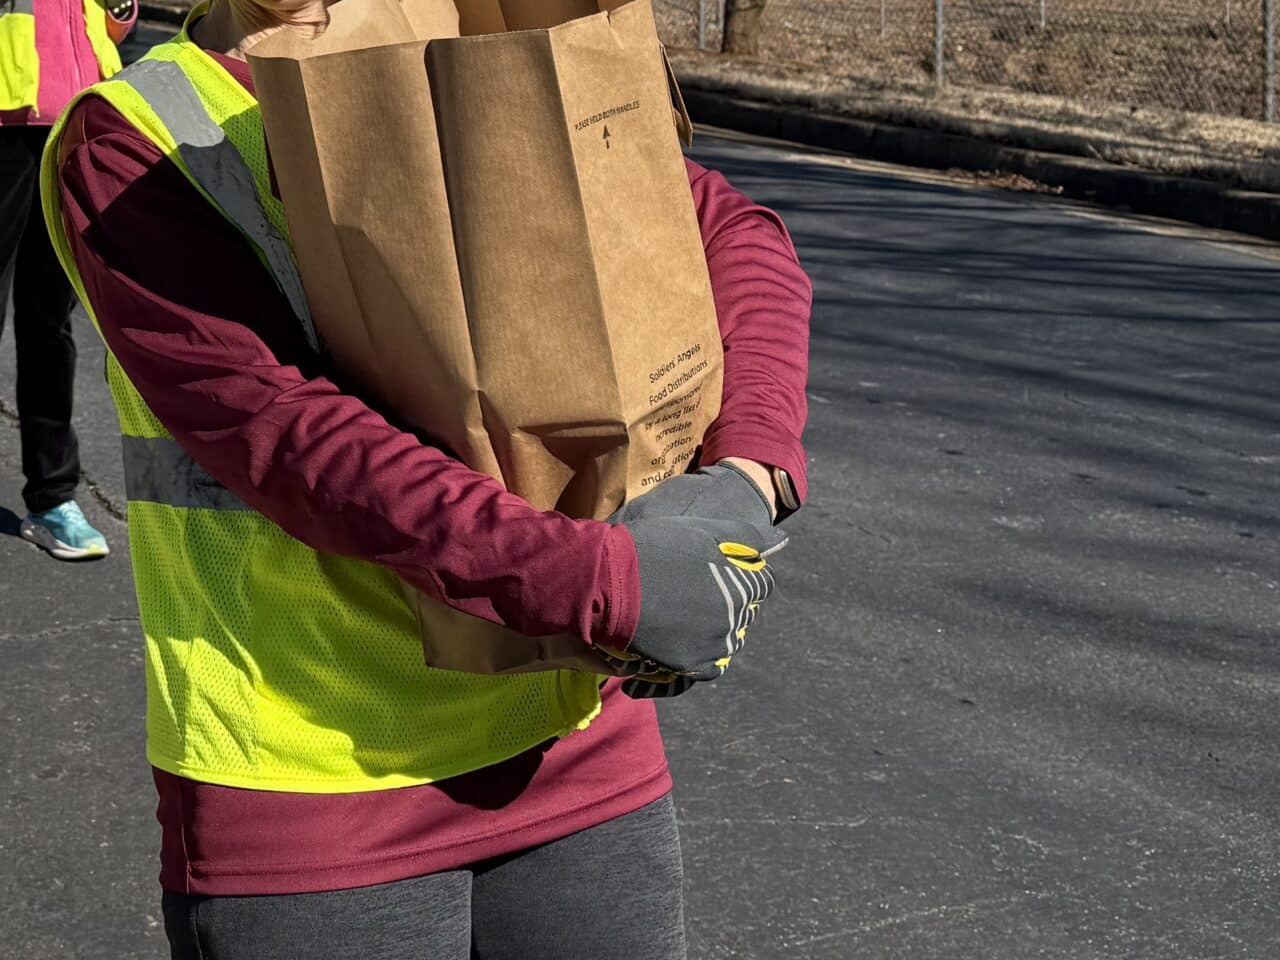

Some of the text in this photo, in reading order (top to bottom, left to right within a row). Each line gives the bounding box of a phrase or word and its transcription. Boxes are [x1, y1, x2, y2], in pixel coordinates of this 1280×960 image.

[677, 343, 701, 363] Angels
[649, 387, 668, 406] Food
[667, 359, 709, 392] Distributions
[641, 472, 661, 486] and
